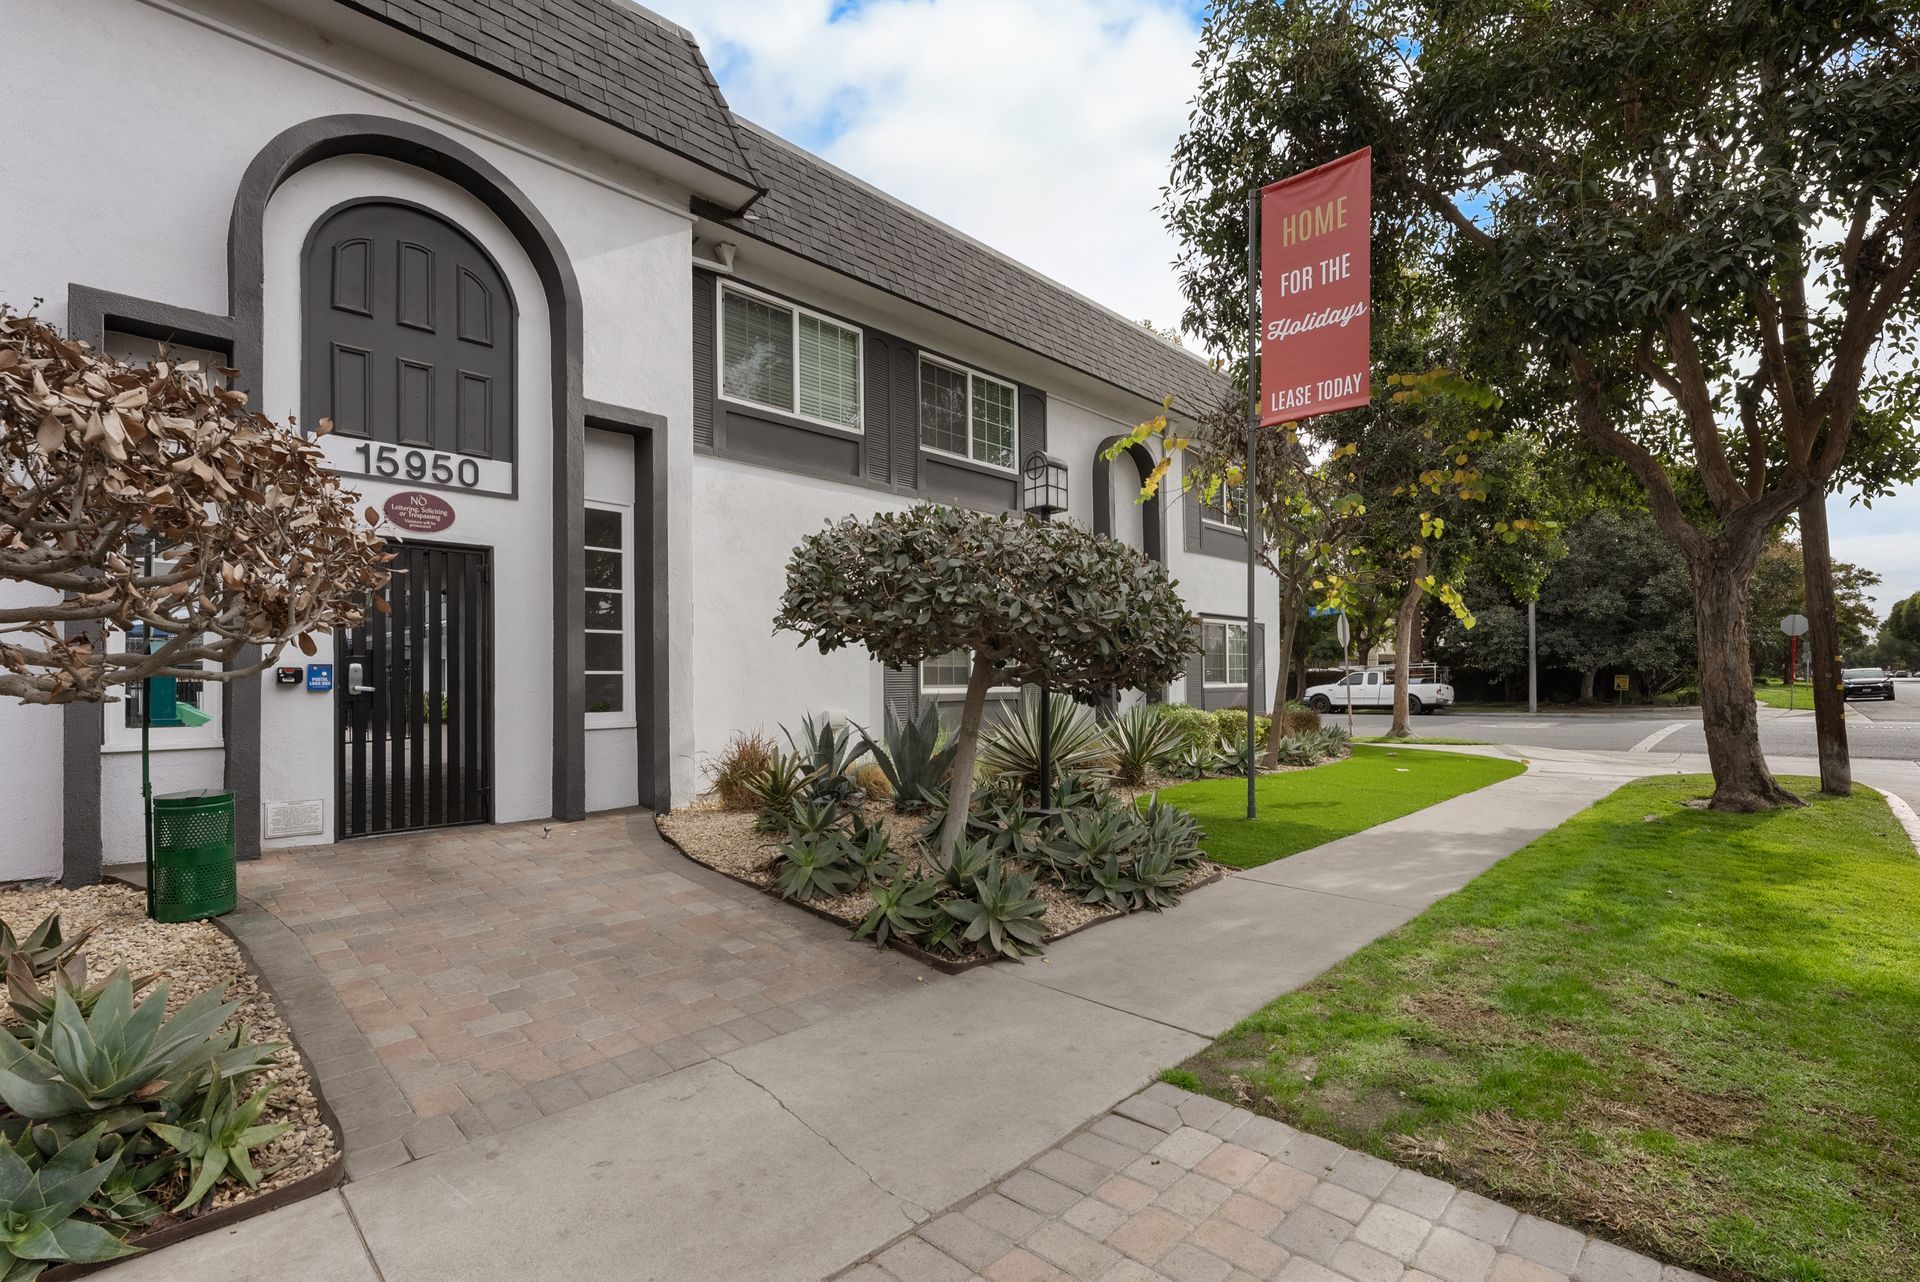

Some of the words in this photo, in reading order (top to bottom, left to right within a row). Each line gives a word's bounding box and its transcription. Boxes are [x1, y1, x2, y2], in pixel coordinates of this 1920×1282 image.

[1283, 195, 1348, 247] HOME
[1280, 266, 1313, 297] FOR
[1320, 253, 1351, 285] THE
[1267, 301, 1368, 341] Holidays
[1271, 384, 1312, 412] LEASE
[1316, 372, 1362, 402] TODAY
[355, 442, 480, 488] 15950
[408, 511, 441, 521] Trespassing
[410, 495, 427, 506] NO
[421, 506, 448, 517] Soliciting
